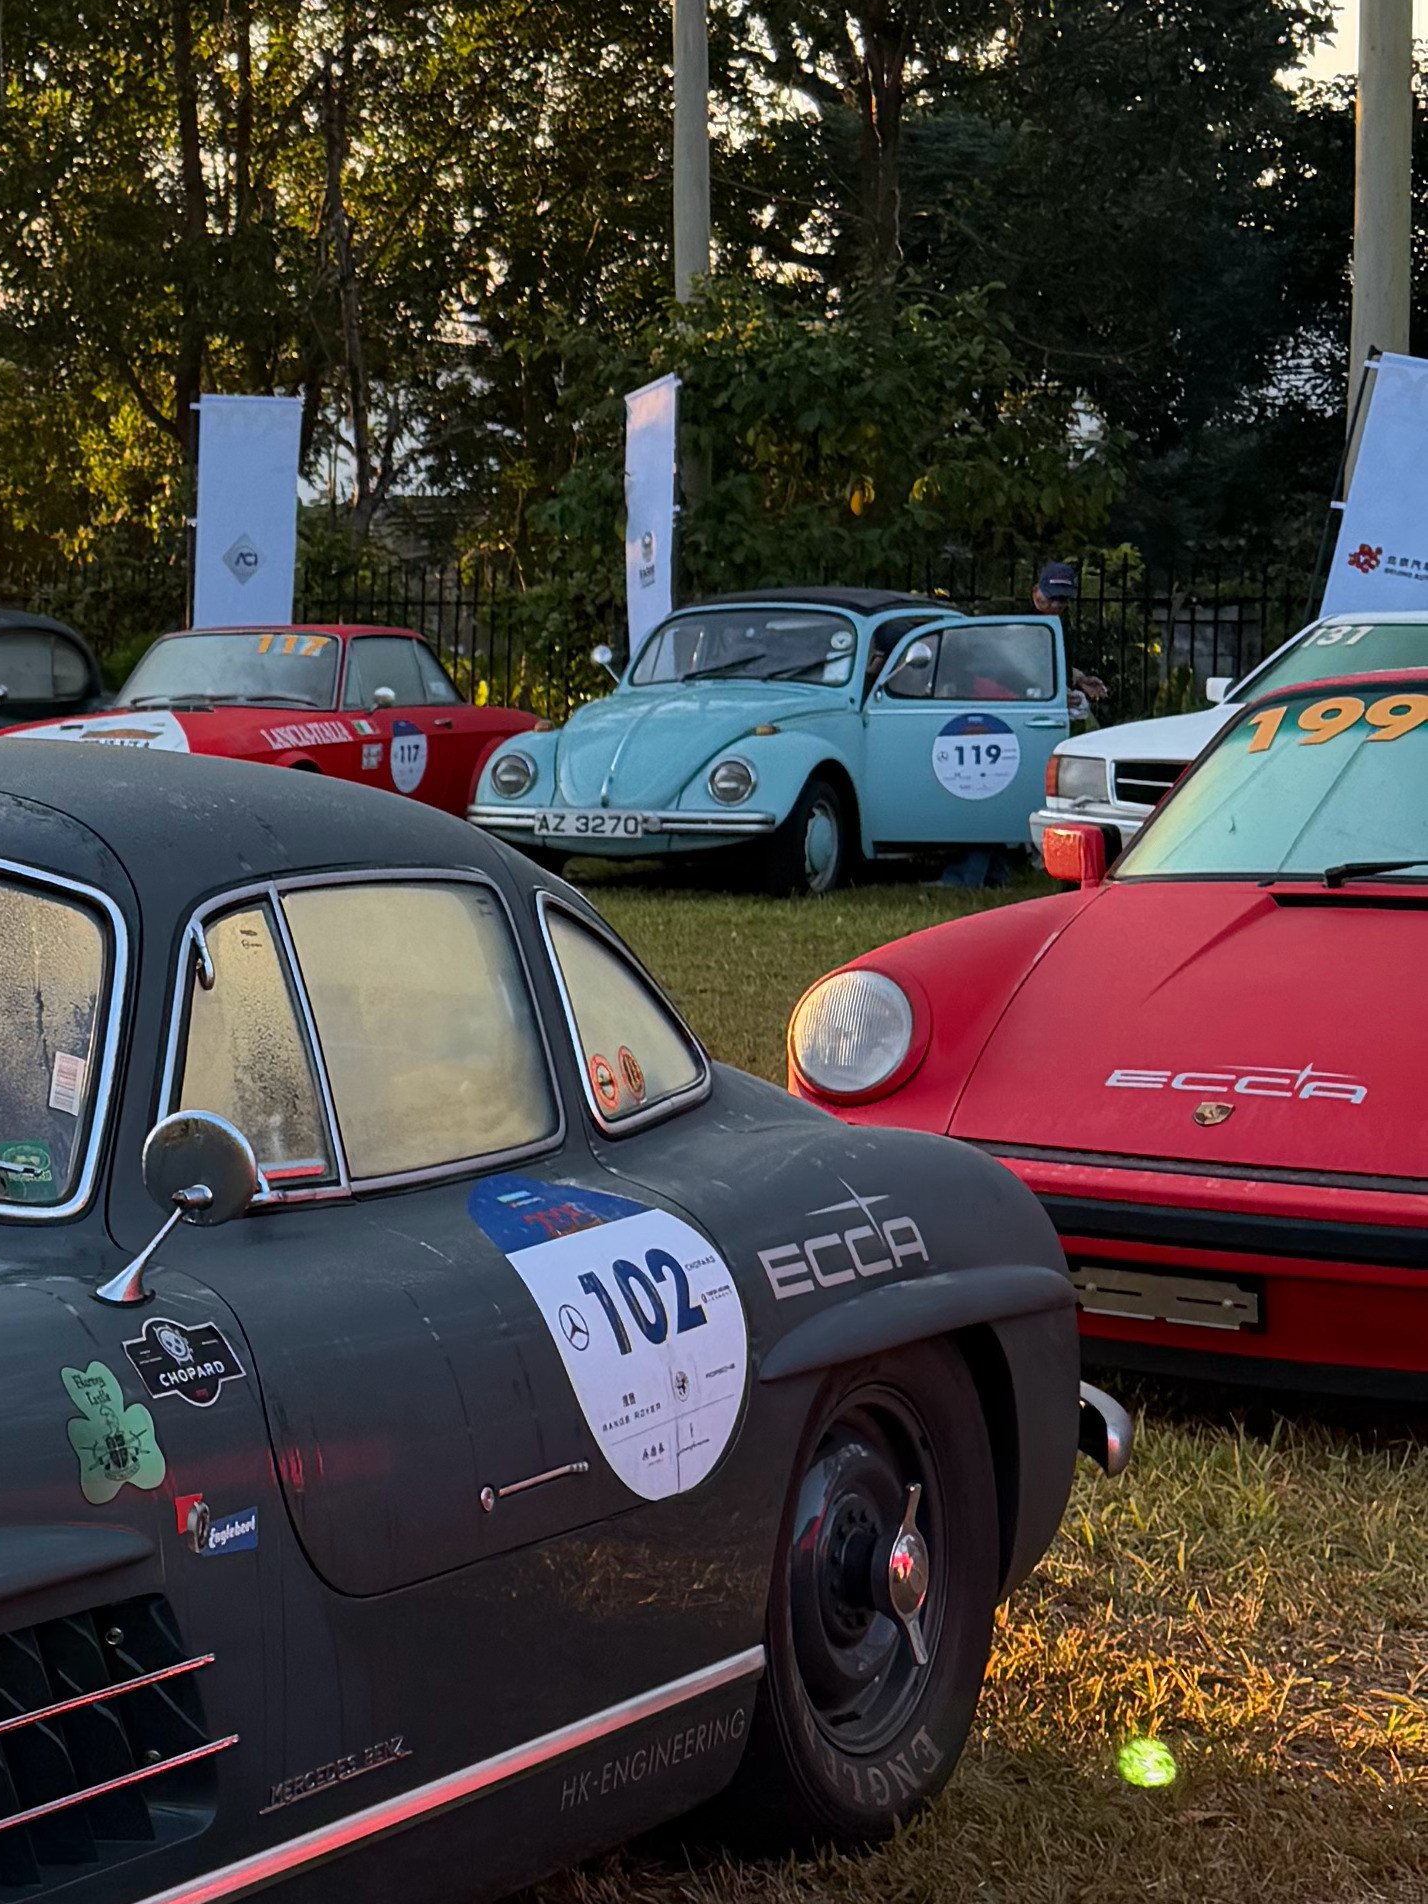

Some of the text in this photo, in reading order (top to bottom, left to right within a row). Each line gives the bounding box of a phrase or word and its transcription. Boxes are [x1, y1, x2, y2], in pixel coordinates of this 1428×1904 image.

[257, 634, 330, 656] 117
[1301, 625, 1375, 648] 131
[1249, 693, 1428, 754] 199
[400, 744, 420, 764] 117
[954, 744, 1002, 766] 119
[538, 813, 639, 835] AZ 3270
[1105, 1066, 1368, 1104] ECCA
[757, 1214, 930, 1301] ECCA
[578, 1248, 707, 1355] 102
[159, 1360, 225, 1387] CHOPARD
[560, 1708, 745, 1812] HK-ENGINEERING
